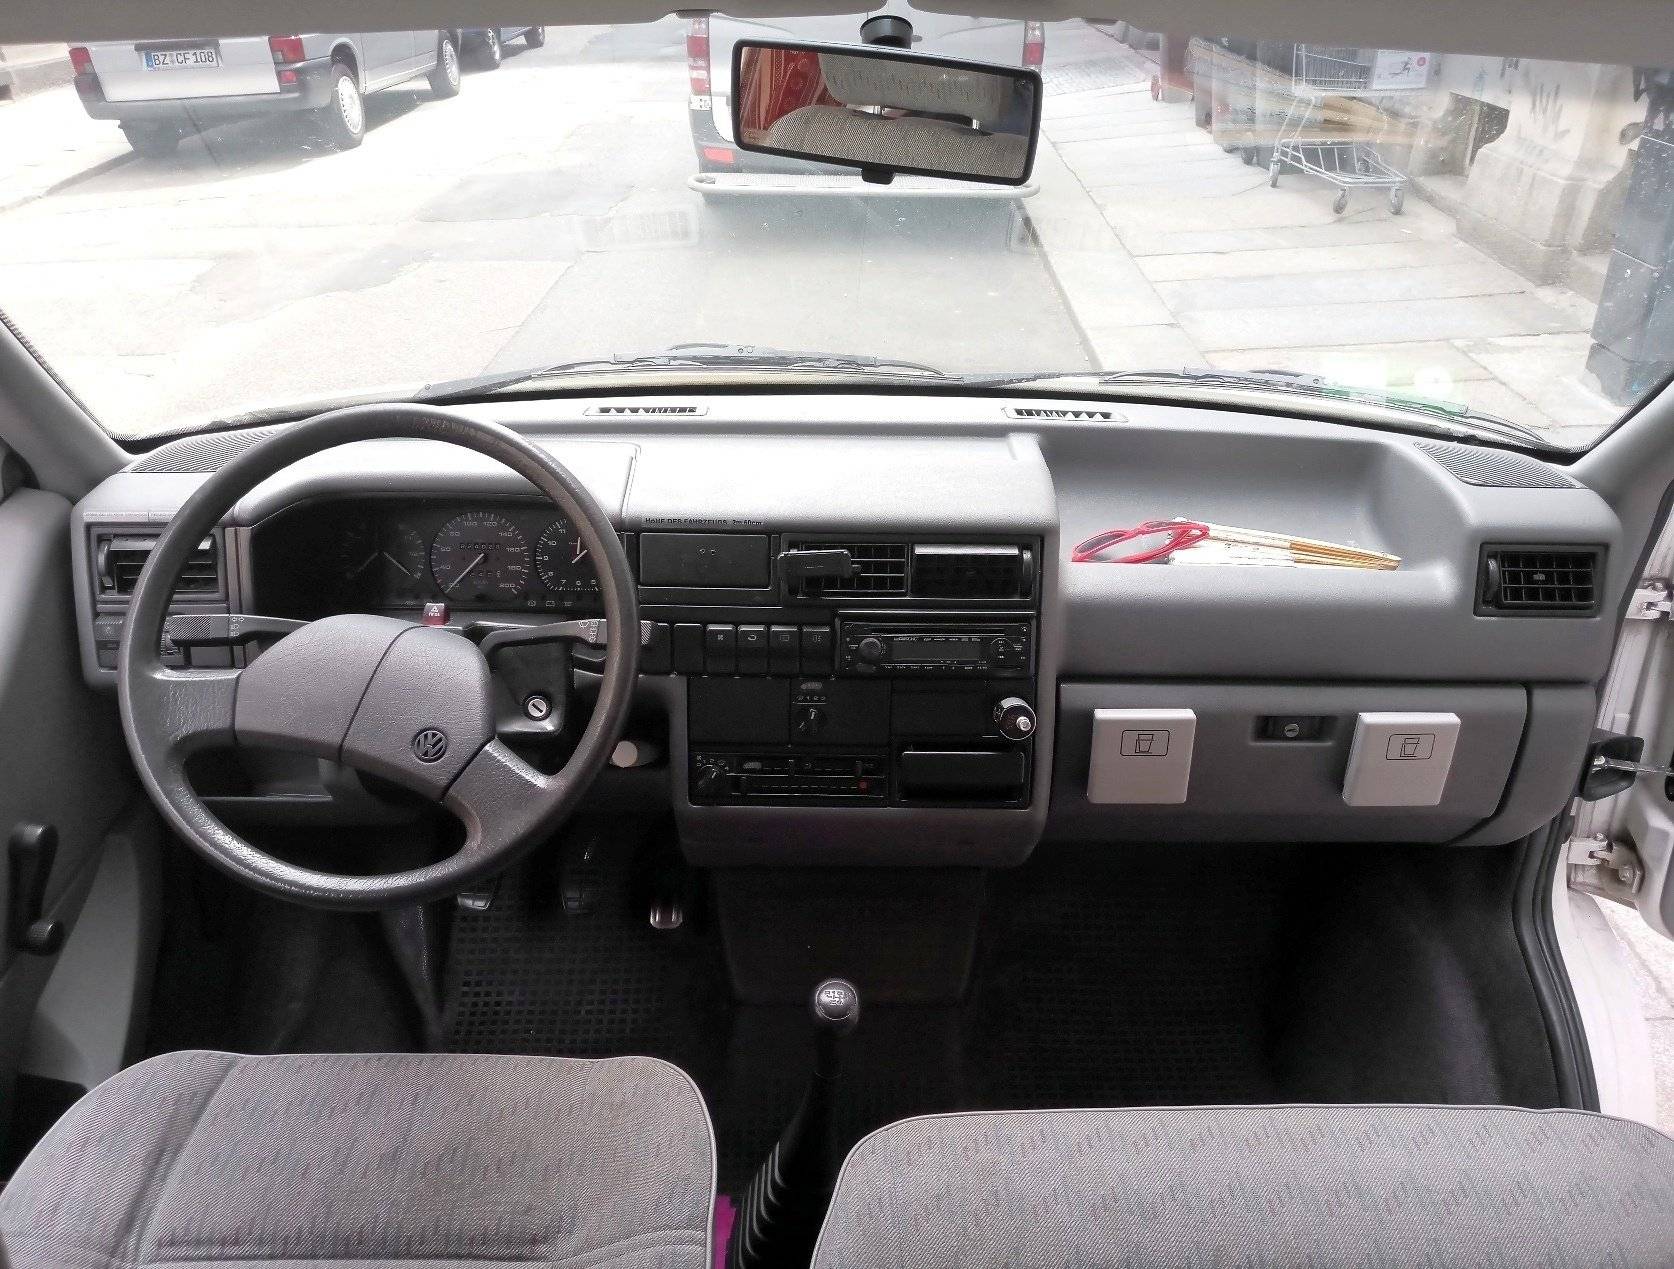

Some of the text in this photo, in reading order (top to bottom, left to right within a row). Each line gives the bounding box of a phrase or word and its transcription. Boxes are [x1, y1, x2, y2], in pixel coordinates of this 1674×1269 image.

[152, 51, 215, 66] BZ CF 108
